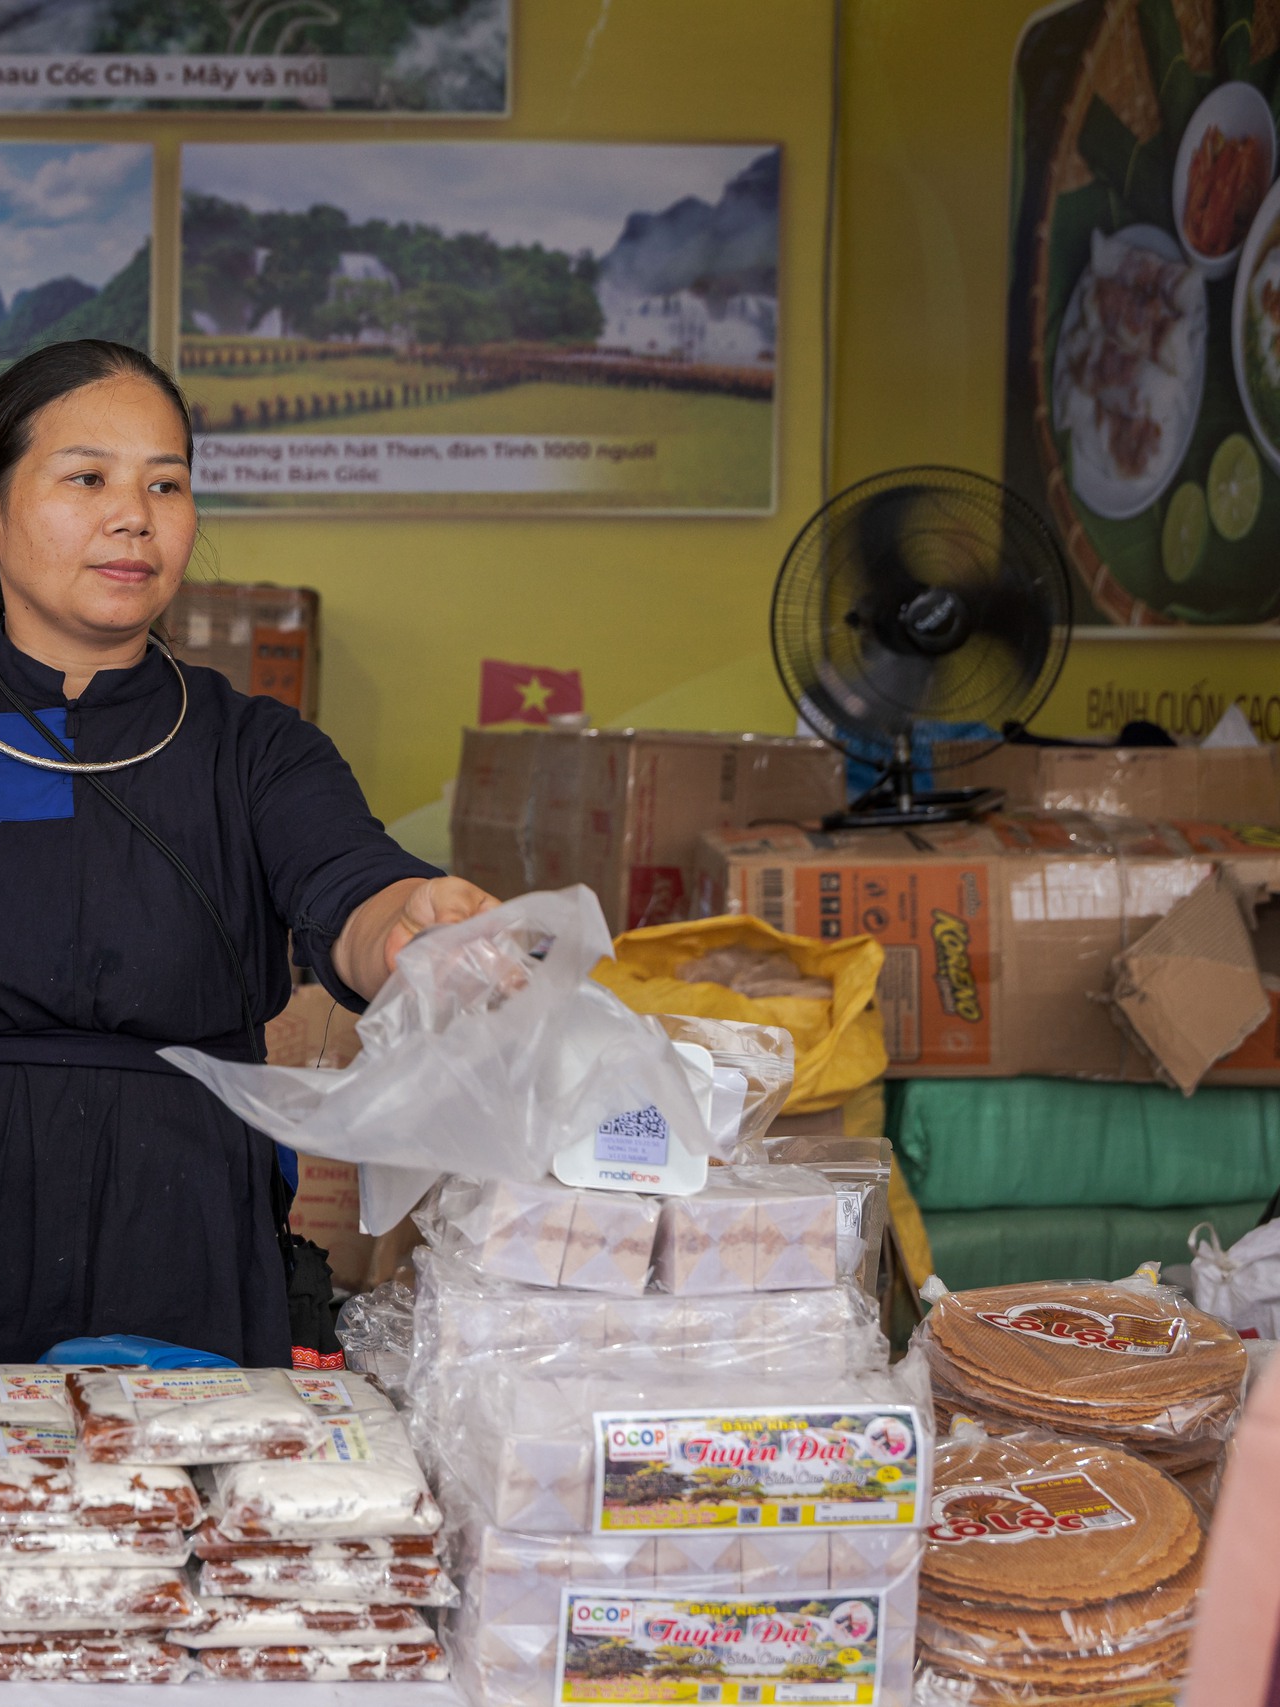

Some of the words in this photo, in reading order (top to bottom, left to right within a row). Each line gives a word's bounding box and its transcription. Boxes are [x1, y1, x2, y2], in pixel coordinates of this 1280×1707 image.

[46, 60, 96, 86] Cốc
[104, 63, 157, 86] Chà
[183, 63, 238, 91] Mây
[246, 63, 276, 86] và
[284, 62, 328, 87] núi
[543, 441, 593, 459] 1000
[599, 1170, 661, 1184] mobifone
[613, 1430, 665, 1446] OCOP
[787, 1435, 848, 1466] Đại
[578, 1606, 630, 1622] OCOP
[752, 1619, 812, 1648] Đại
